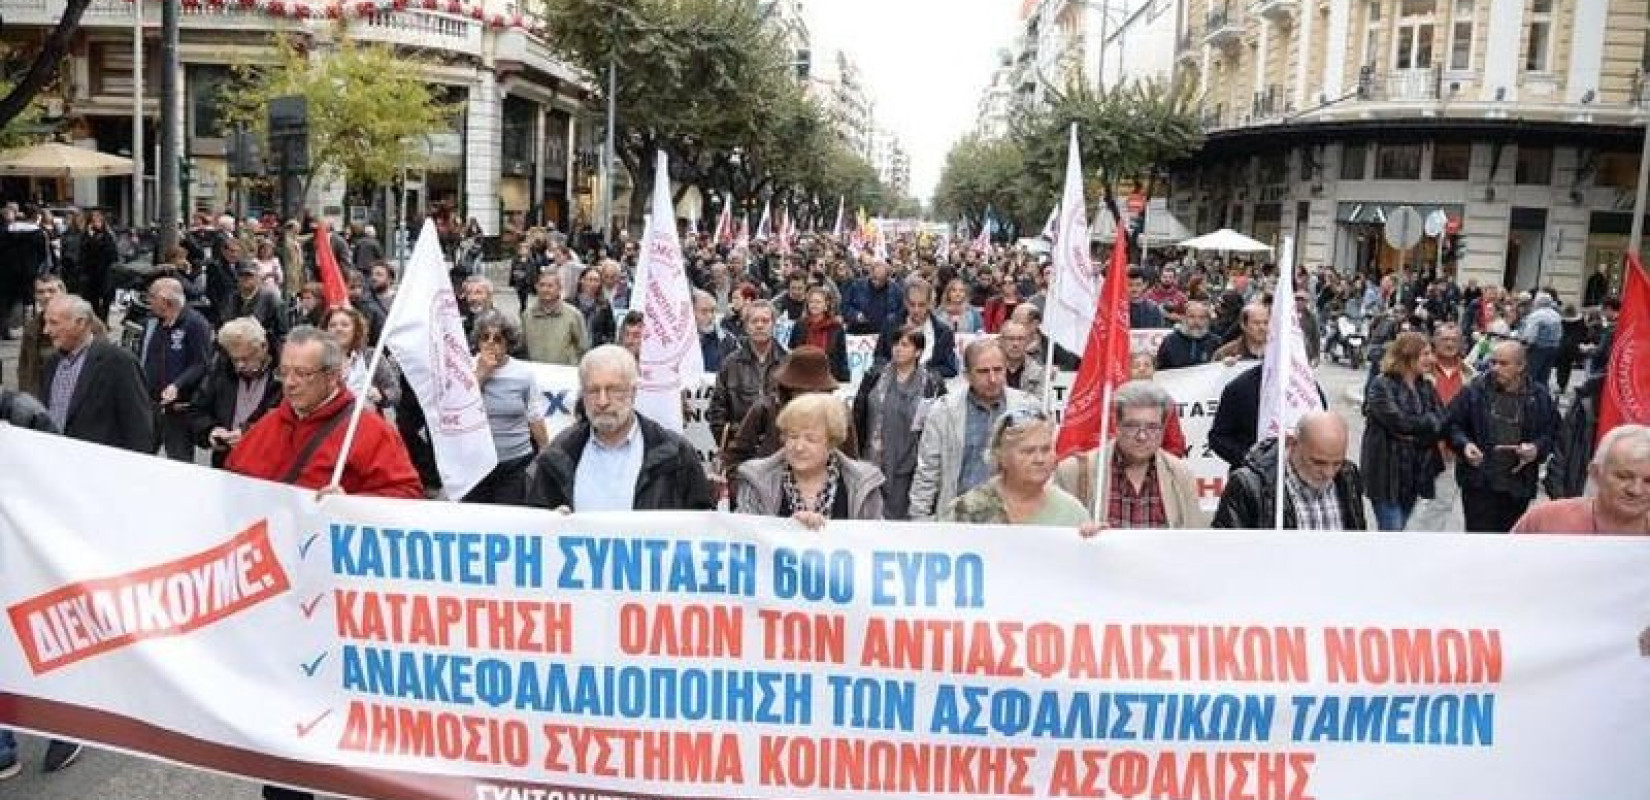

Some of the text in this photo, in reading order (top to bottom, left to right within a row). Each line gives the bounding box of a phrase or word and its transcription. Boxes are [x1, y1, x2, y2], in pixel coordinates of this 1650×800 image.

[28, 542, 275, 663] ΔΙΕΚΔΙΚΟΥΜΕ:
[330, 524, 984, 609] ΚΑΤΩΤΕΡΗ ΣΥΝΤΑΞΗ 600 ΕΥΡΩ
[335, 589, 1503, 685] ΚΑΤΑΡΓΗΣΗ ΟΛΩΝ ΤΩΝ ΑΝΤΙΑΣΦΑΛΙΣΤΙΚΩΝ ΝΟΜΩΝ
[341, 645, 1495, 747] ΑΝΑΚΕΦΑΛΑΙΟΠΟΙΗΣΗ ΤΩΝ ΑΣΦΑΛΙΣΤΙΚΩΝ ΤΑΜΕΙΩΝ
[337, 700, 1316, 800] ΔΗΜΟΣΙΟ ΣΥΣΤΗΜΑ ΚΟΙΝΩΝΙΚΗΣ ΑΣΦΑΛΙΣΗΣ
